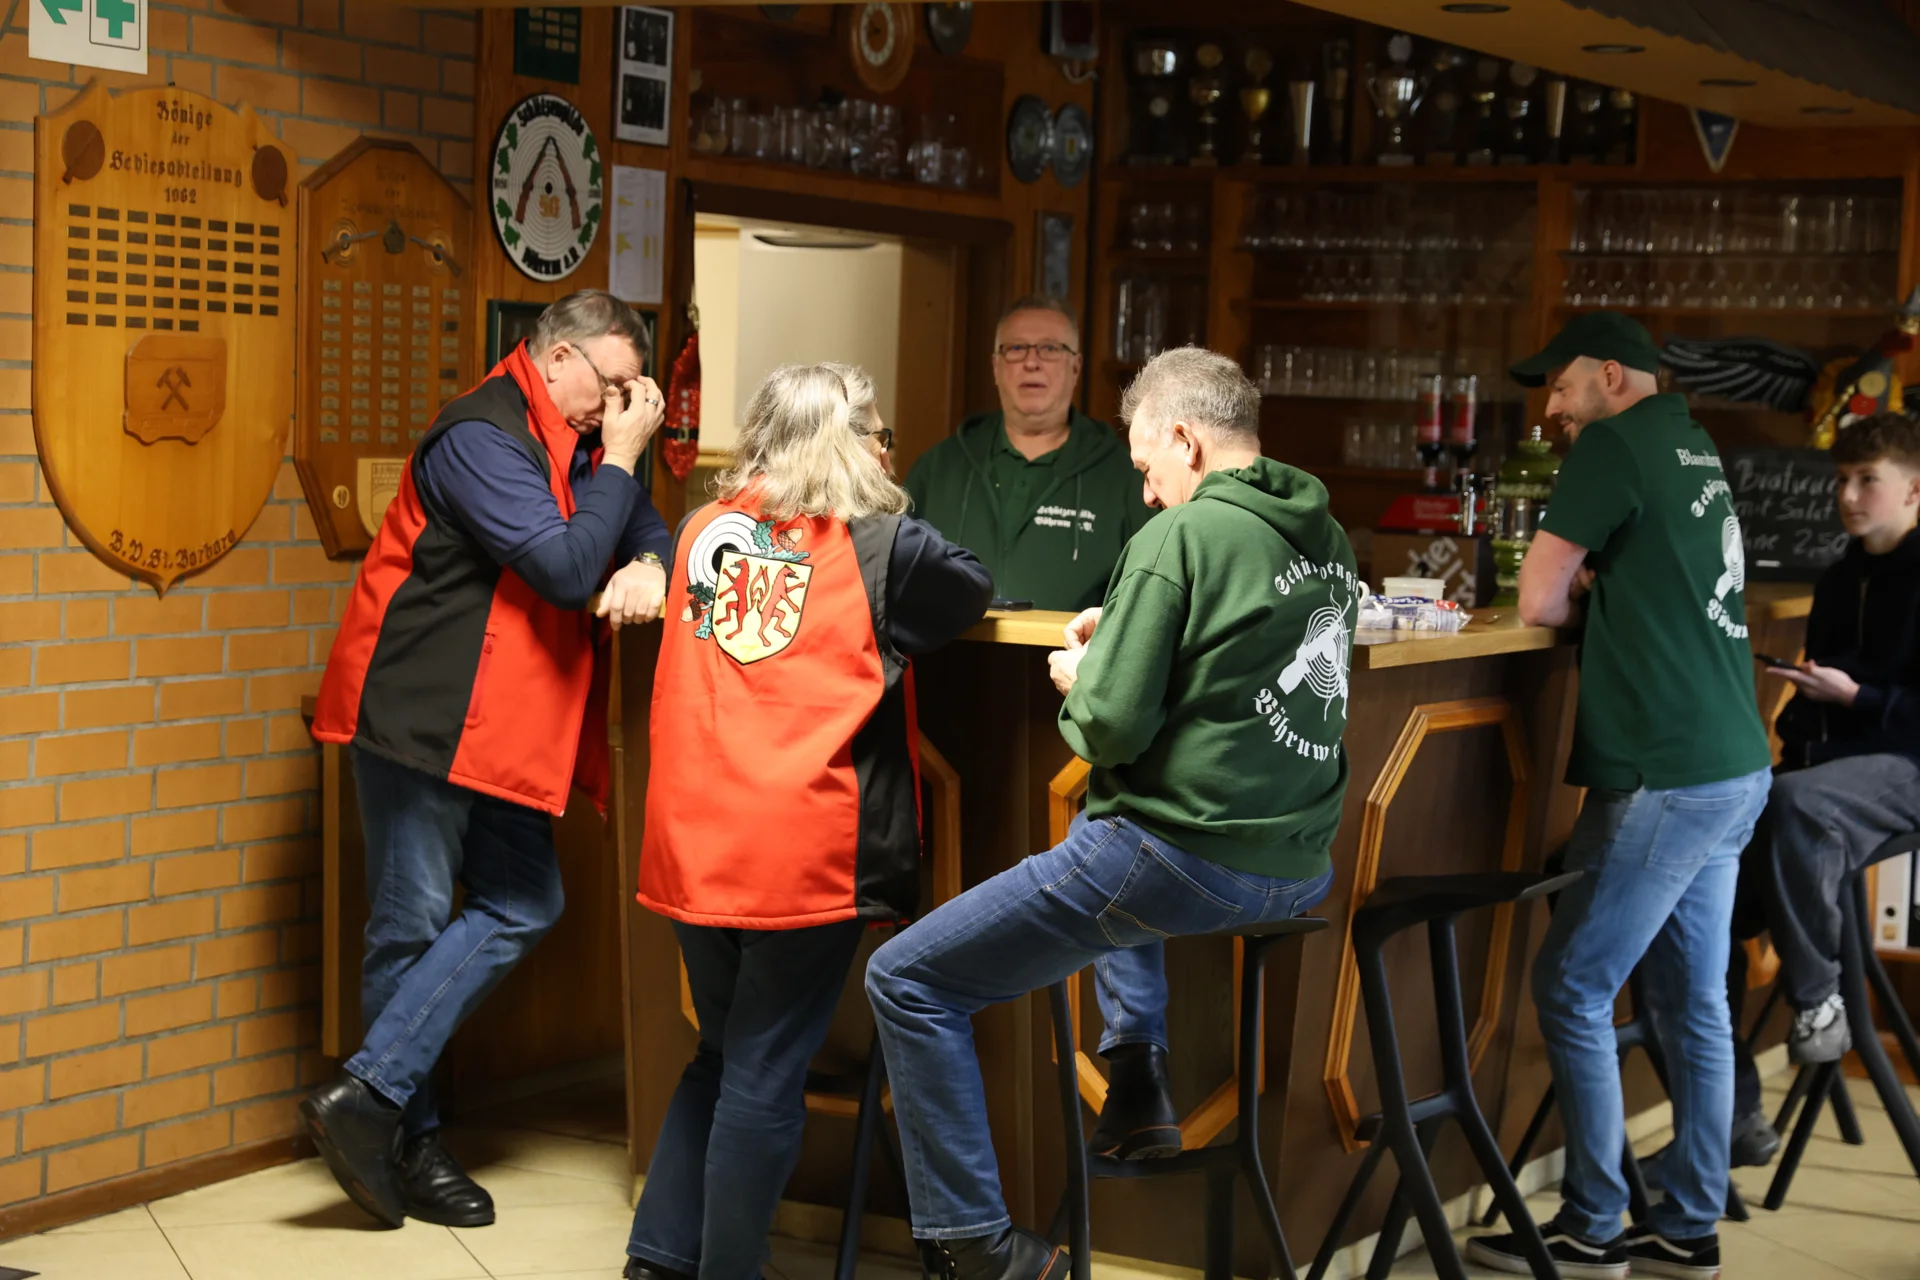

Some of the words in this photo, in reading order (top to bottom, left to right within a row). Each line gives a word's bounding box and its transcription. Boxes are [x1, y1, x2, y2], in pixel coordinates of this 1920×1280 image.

[164, 187, 197, 204] 1962
[538, 194, 561, 219] 50
[1252, 687, 1330, 763] Vöhrum
